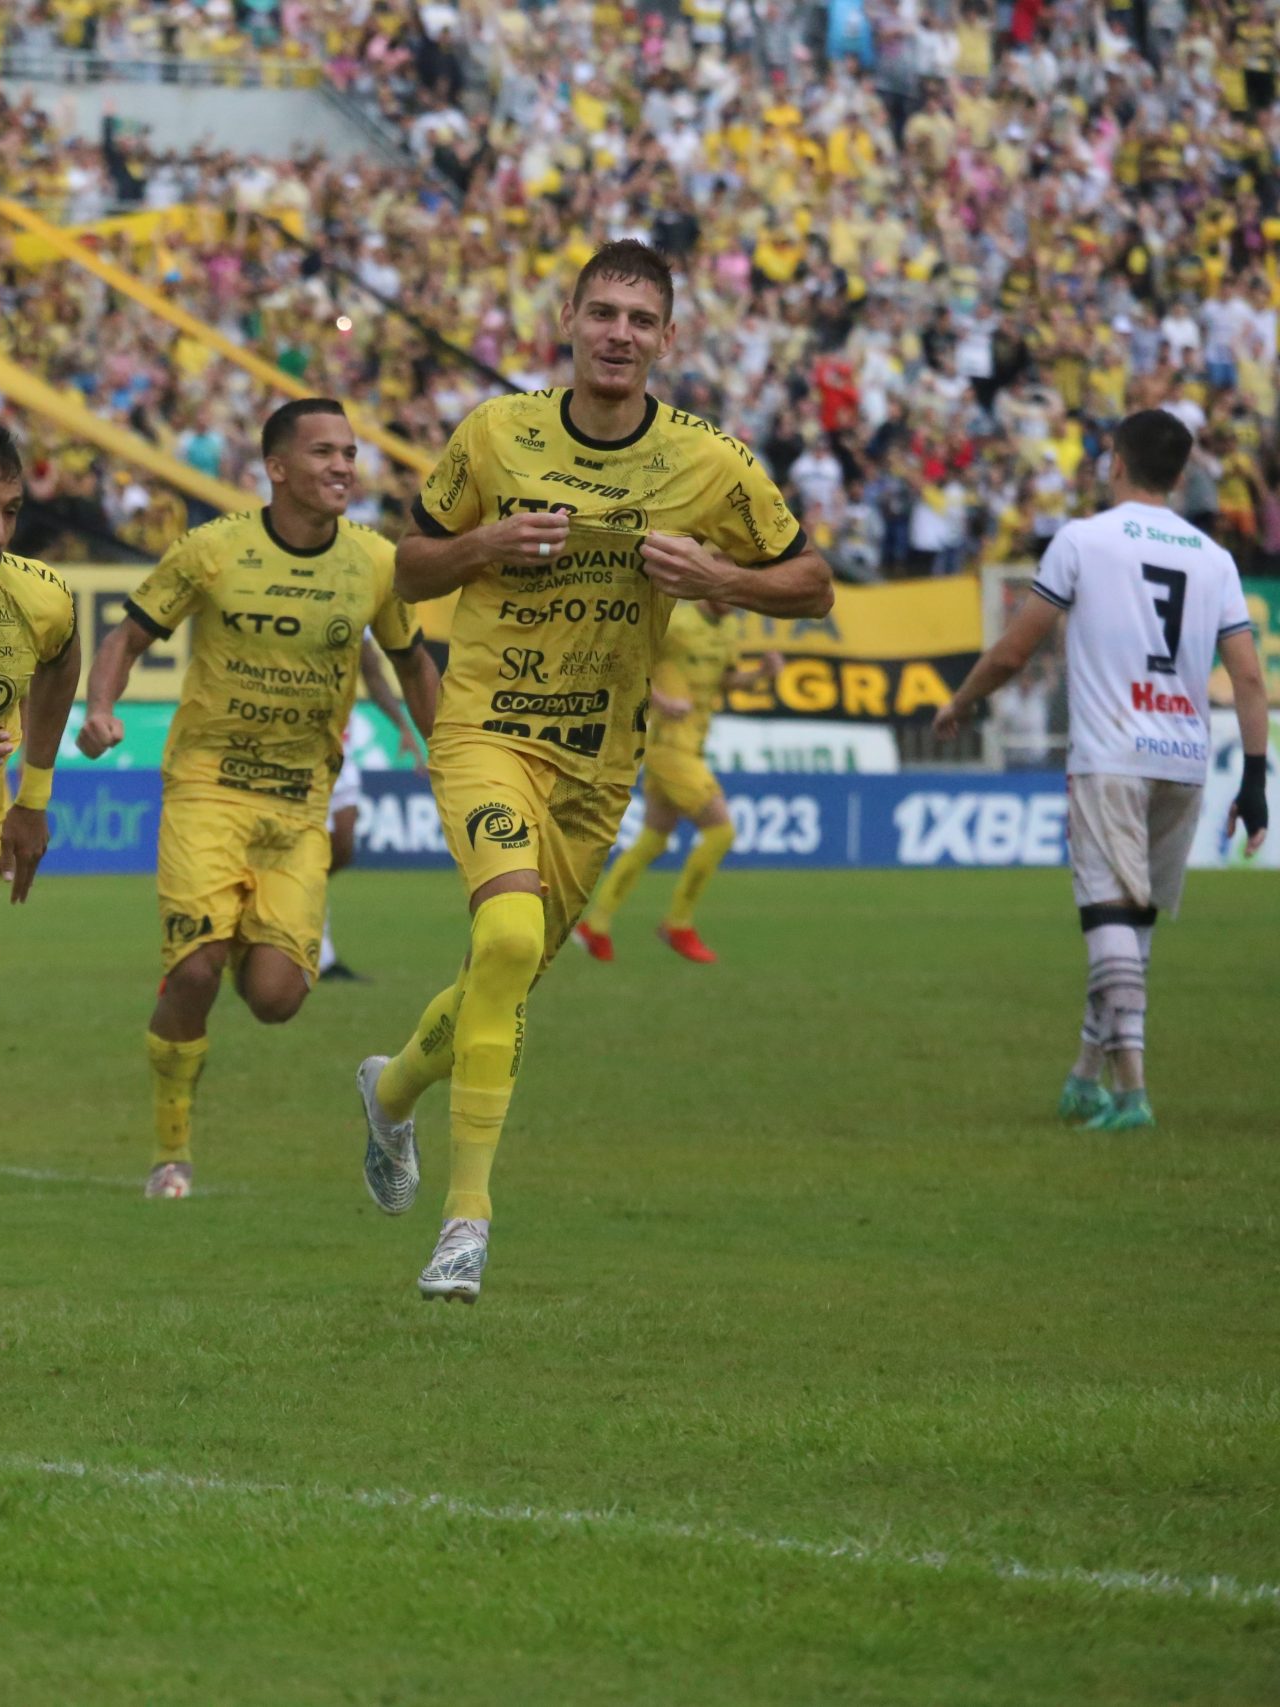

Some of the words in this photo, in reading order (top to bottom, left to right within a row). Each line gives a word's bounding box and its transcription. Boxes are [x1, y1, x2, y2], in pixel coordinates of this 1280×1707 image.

[514, 435, 546, 449] SICOOB
[670, 408, 754, 468] HAVAN
[540, 470, 630, 501] EUCATUR
[1147, 527, 1202, 550] Sicredi
[264, 585, 336, 601] EUCATUR
[222, 610, 301, 637] KTO
[499, 598, 587, 625] FOSFO
[593, 599, 640, 626] 500
[1141, 562, 1187, 675] 3
[227, 698, 300, 724] FOSFO
[354, 793, 450, 852] PAR
[704, 794, 822, 855] 023
[893, 791, 1066, 866] 1XBE
